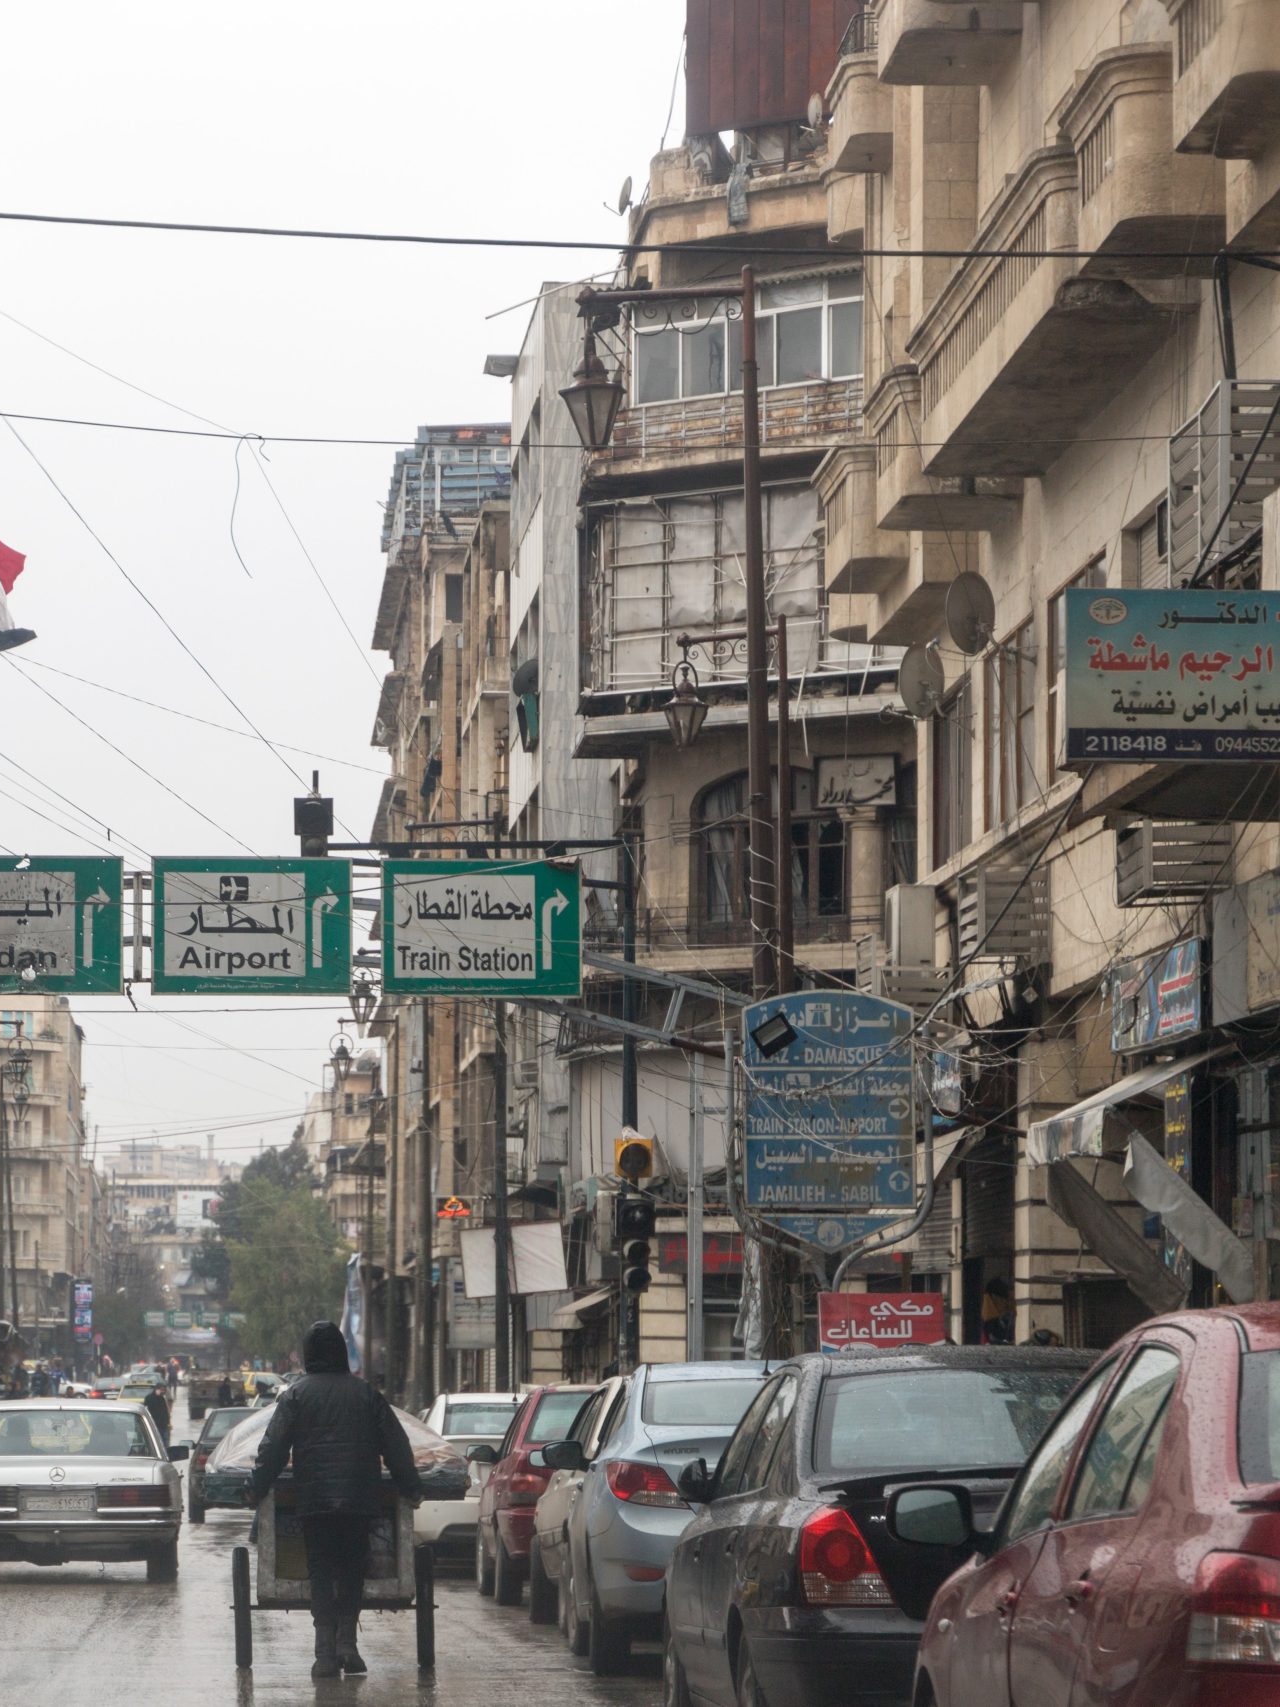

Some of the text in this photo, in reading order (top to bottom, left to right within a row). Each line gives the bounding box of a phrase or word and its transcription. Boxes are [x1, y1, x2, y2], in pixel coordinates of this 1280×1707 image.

[1156, 601, 1268, 629] الدكتور
[1087, 632, 1274, 682] الرحيم ماشطة
[1110, 689, 1177, 722] نفسية
[1182, 688, 1248, 723] أمراض
[1086, 736, 1167, 752] 2118418
[1215, 737, 1280, 752] 0944552
[177, 904, 295, 936] المطار
[395, 888, 533, 929] محطة القطار
[178, 946, 291, 975] Airport
[397, 945, 534, 972] Train Station
[805, 1046, 884, 1065] DAMASCUS
[752, 1117, 784, 1134] TRAIN
[756, 1142, 813, 1171] السبيل
[758, 1184, 826, 1202] JAMILIEH
[841, 1184, 882, 1202] SABIL
[869, 1300, 934, 1321] مكي
[826, 1319, 913, 1339] للساعات
